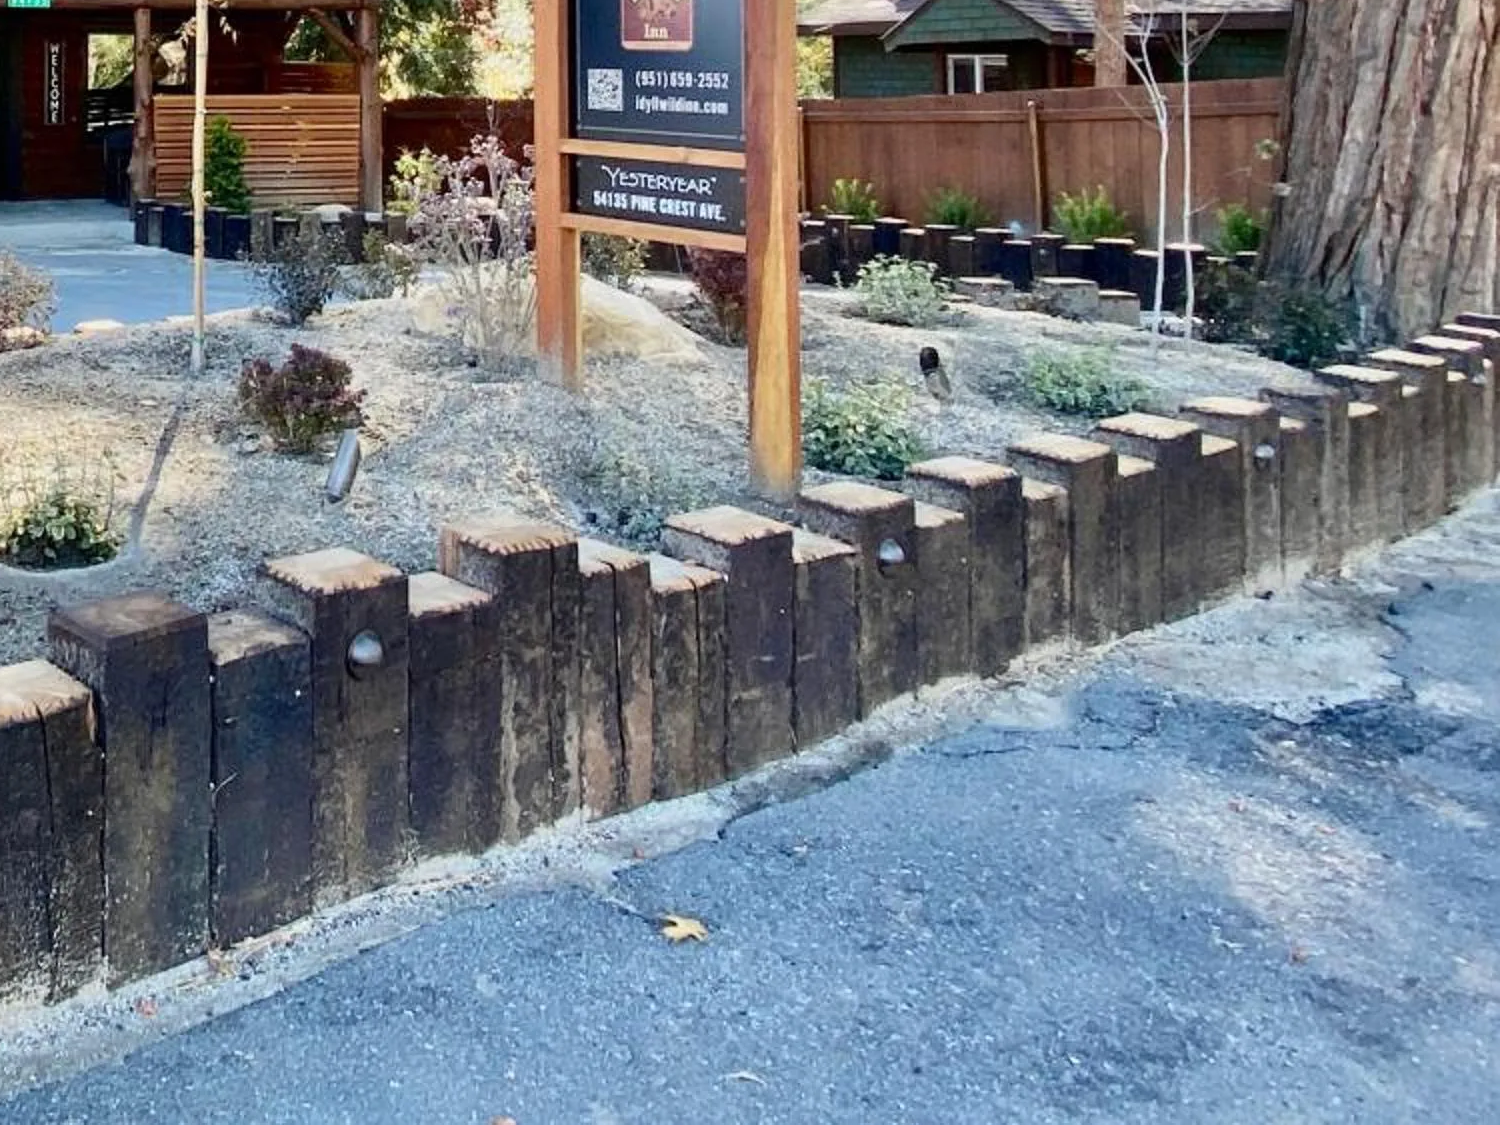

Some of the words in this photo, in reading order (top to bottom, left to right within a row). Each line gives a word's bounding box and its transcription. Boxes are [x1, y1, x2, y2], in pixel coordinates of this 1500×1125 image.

[644, 23, 669, 39] Inn
[49, 42, 60, 124] WELCOME
[631, 194, 657, 214] PINE
[659, 197, 697, 218] CREST
[699, 203, 727, 222] AVE.
